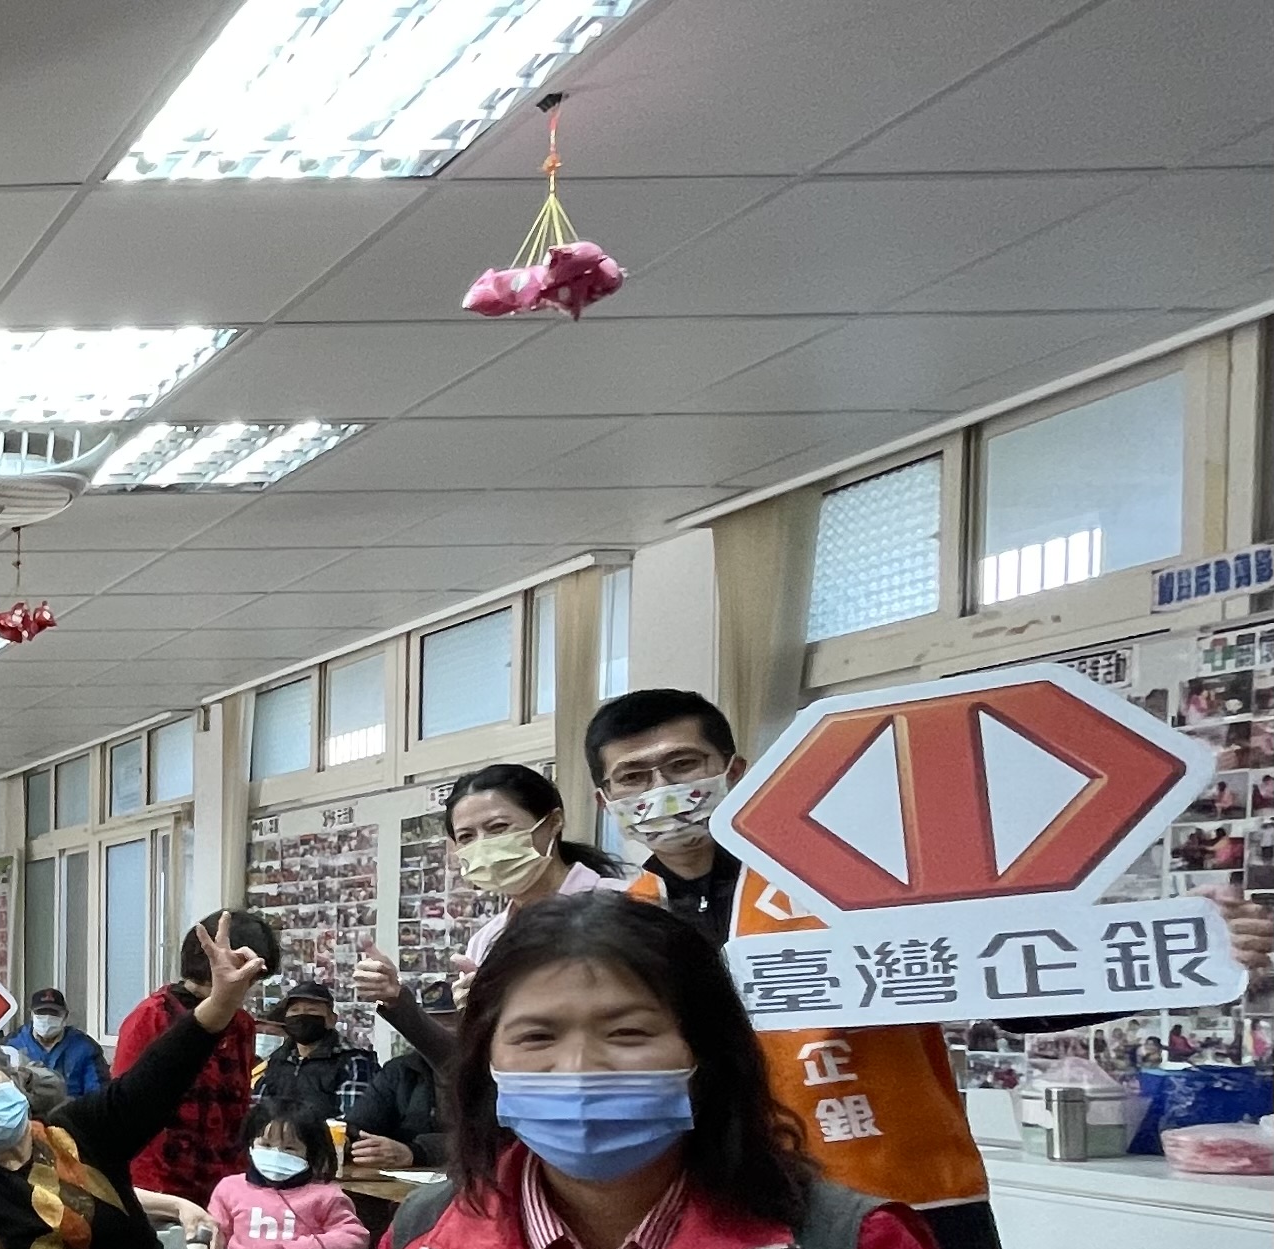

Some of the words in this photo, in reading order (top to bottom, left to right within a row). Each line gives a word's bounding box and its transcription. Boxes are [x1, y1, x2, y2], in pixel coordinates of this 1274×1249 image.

[742, 916, 1219, 1015] 臺灣企銀
[796, 1040, 884, 1142] 企銀
[249, 1206, 296, 1240] hi
